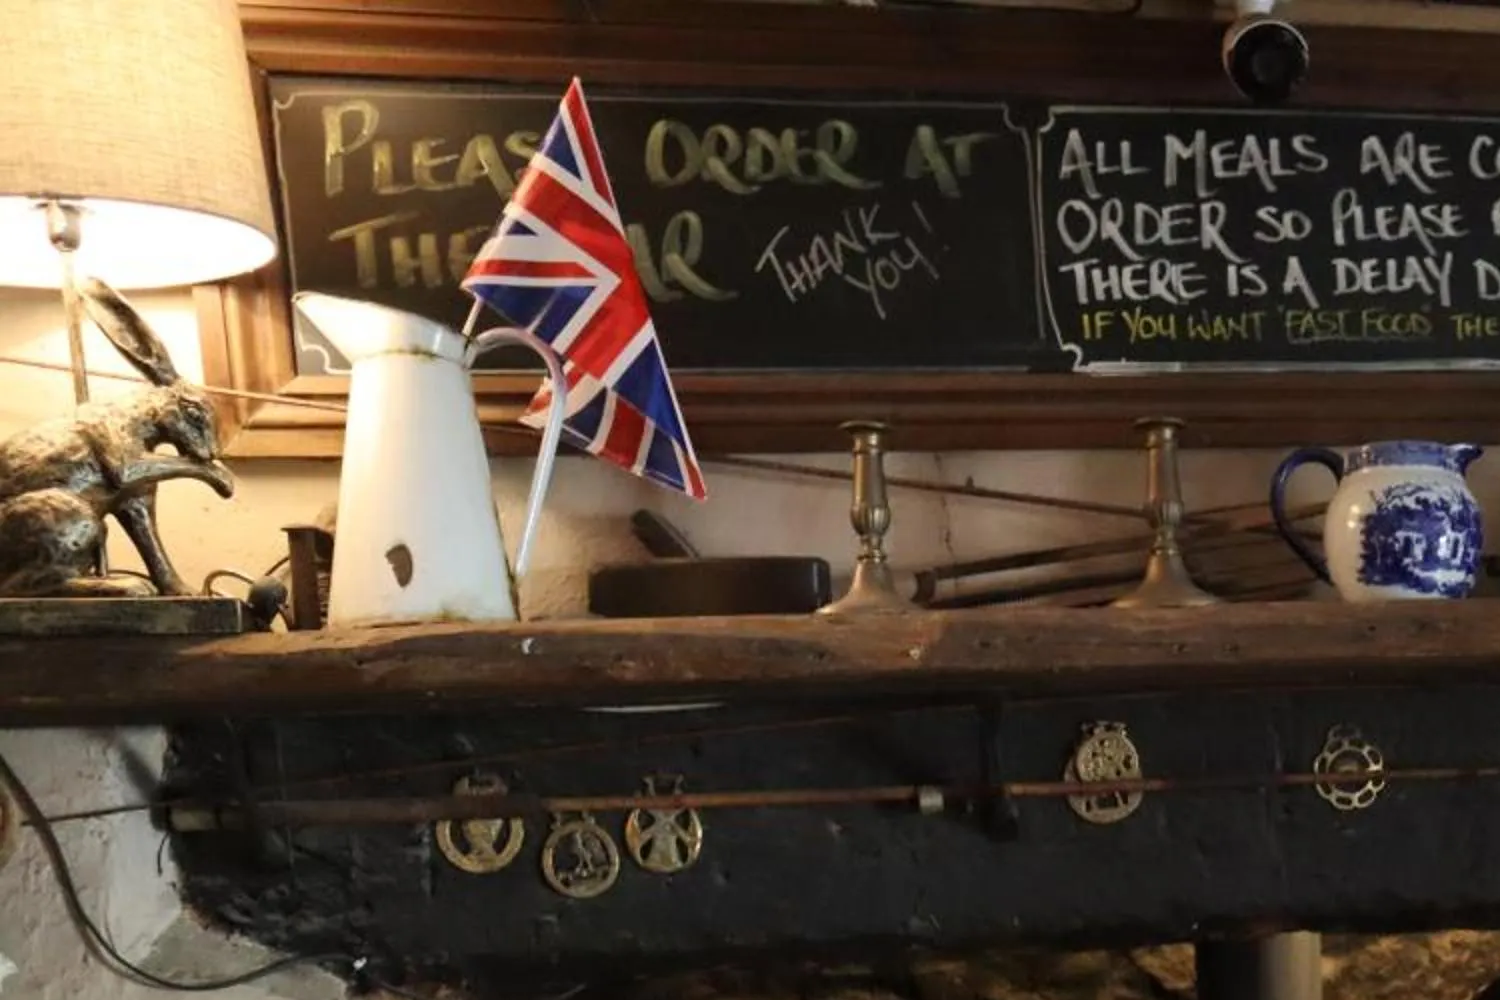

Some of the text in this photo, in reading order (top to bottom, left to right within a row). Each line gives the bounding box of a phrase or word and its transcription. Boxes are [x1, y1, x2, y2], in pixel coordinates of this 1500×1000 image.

[321, 100, 999, 199] PLEAS ORDER AT
[1059, 128, 1149, 199] ALL
[1164, 129, 1329, 197] MEALS
[1360, 131, 1454, 194] ARE
[625, 210, 740, 303] AR
[755, 203, 901, 304] THANK
[1057, 198, 1252, 264] ORDER
[1253, 205, 1312, 242] SO
[1331, 188, 1470, 255] PLEASE
[1059, 258, 1208, 305] THERE
[1227, 262, 1268, 298] IS
[1283, 255, 1320, 309] A
[1331, 251, 1453, 307] DELAY
[1082, 311, 1115, 340] IF
[1123, 306, 1177, 341] YOU
[1187, 310, 1267, 342] WANT
[1451, 312, 1498, 341] THE
